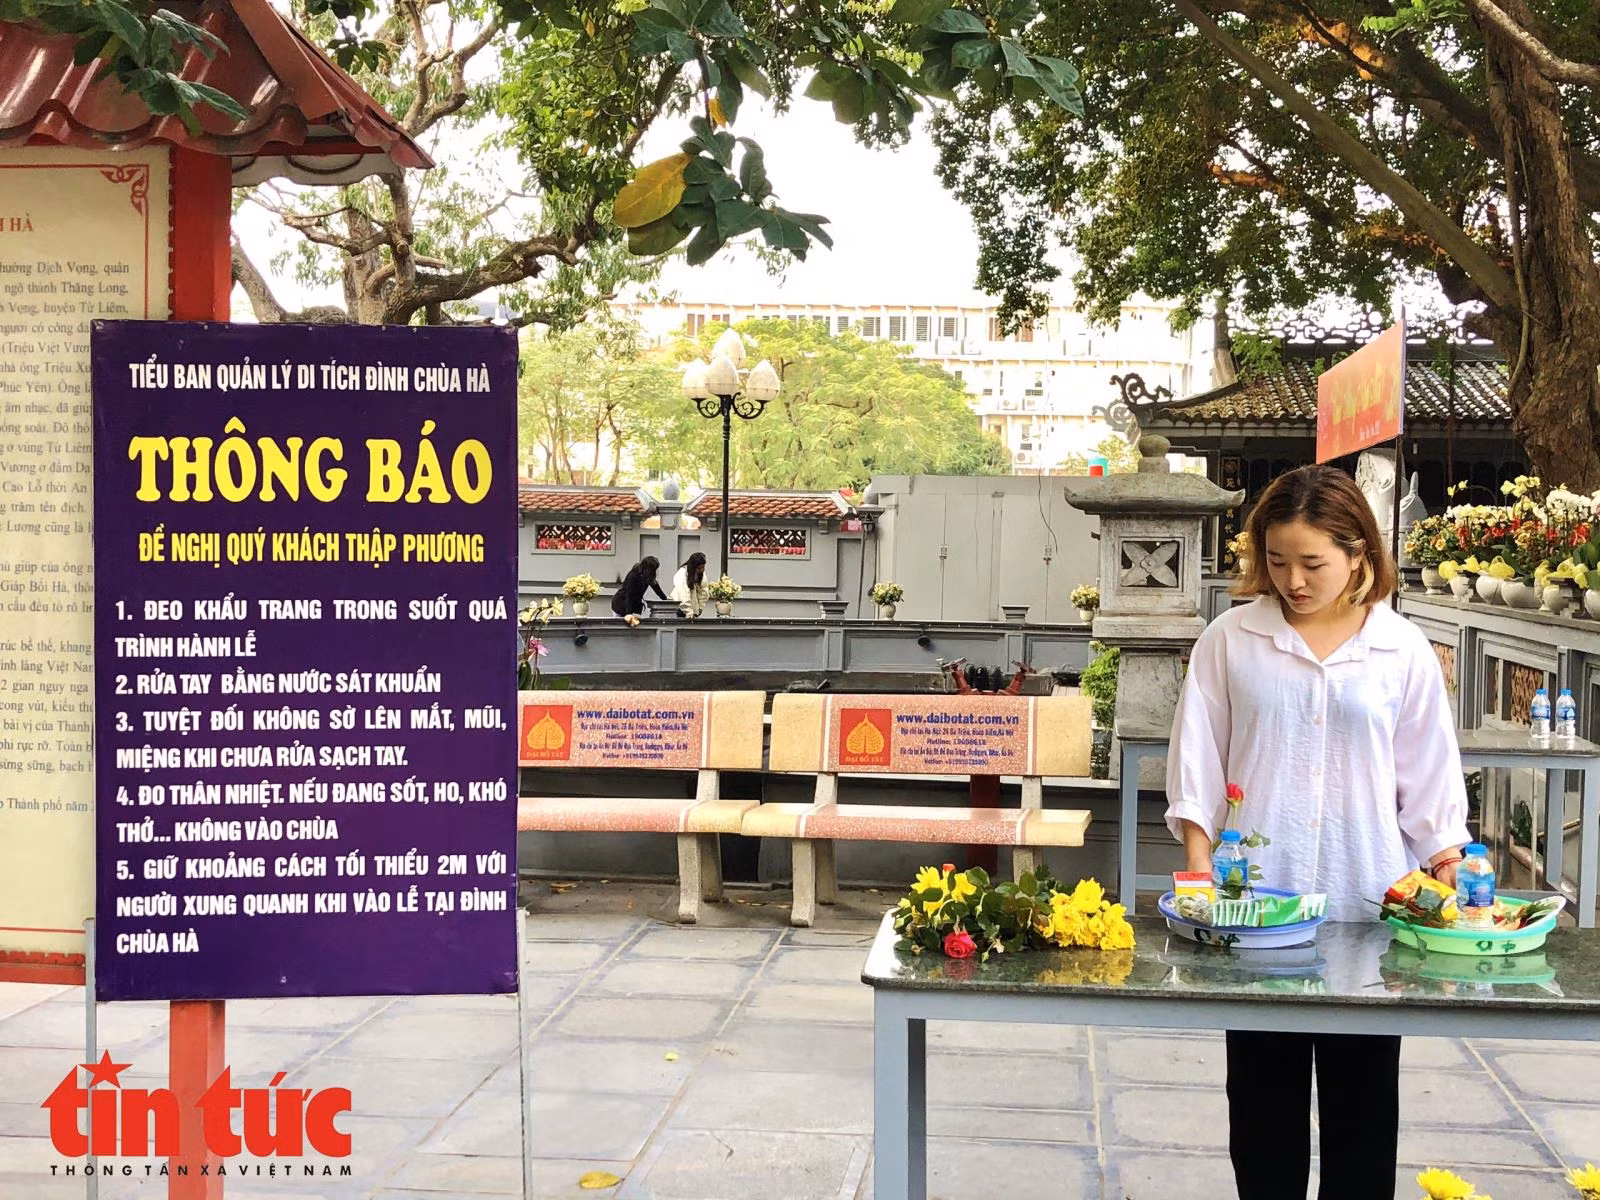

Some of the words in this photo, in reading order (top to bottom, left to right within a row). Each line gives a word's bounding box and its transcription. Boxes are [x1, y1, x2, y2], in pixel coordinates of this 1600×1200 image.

[9, 212, 33, 232] HÀ
[37, 262, 62, 275] Dịch
[103, 262, 129, 275] quận
[60, 282, 95, 296] Thăng
[43, 302, 76, 316] huyện
[32, 322, 44, 333] có
[48, 322, 73, 336] công
[2, 341, 34, 355] (Triệu
[38, 341, 60, 355] Việt
[20, 362, 39, 375] ông
[44, 361, 72, 375] Triệu
[129, 354, 168, 388] TIỂU
[174, 364, 211, 389] BAN
[217, 357, 266, 392] QUẢN
[272, 360, 292, 389] LÝ
[298, 365, 315, 389] DI
[321, 360, 360, 390] TÍCH
[365, 362, 408, 391] ĐÌNH
[414, 363, 461, 392] CHÙA
[467, 363, 490, 392] HÀ
[58, 378, 81, 396] Ông
[56, 402, 69, 413] đã
[18, 443, 43, 455] vùng
[129, 417, 347, 502] THÔNG
[366, 420, 492, 504] BÁO
[1, 461, 36, 476] Vương
[2, 481, 23, 492] Cao
[28, 479, 42, 492] Lỗ
[46, 481, 67, 493] thời
[72, 482, 87, 493] An
[11, 502, 35, 512] trăm
[40, 501, 56, 512] tên
[7, 520, 41, 535] Lương
[44, 521, 70, 535] cũng
[74, 521, 84, 533] là
[139, 523, 164, 561] ĐỀ
[172, 533, 220, 568] NGHỊ
[227, 527, 265, 565] QUÝ
[273, 527, 339, 561] KHÁCH
[345, 528, 396, 568] THẬP
[404, 532, 483, 562] PHƯƠNG
[14, 562, 37, 575] giúp
[41, 562, 59, 572] của
[63, 562, 83, 576] ông
[0, 580, 26, 595] Giáp
[116, 601, 132, 620] 1.
[144, 600, 182, 620] ĐEO
[195, 592, 247, 620] KHẨU
[259, 600, 321, 619] TRANG
[333, 600, 397, 619] TRONG
[409, 594, 457, 620] SUỐT
[469, 596, 507, 621] QUÁ
[21, 636, 33, 651] bề
[60, 640, 92, 656] khang
[115, 633, 173, 657] TRÌNH
[177, 633, 230, 657] HÀNH
[235, 630, 256, 656] LỄ
[21, 660, 43, 674] làng
[47, 660, 69, 675] Việt
[116, 675, 133, 694] 2.
[137, 668, 177, 694] RỬA
[180, 674, 212, 694] TAY
[222, 666, 274, 693] BẰNG
[279, 669, 331, 693] NƯỚC
[336, 669, 372, 692] SÁT
[376, 665, 440, 692] KHUẨN
[12, 681, 35, 693] gian
[39, 682, 65, 695] nguy
[70, 683, 89, 696] nga
[28, 700, 48, 713] vút,
[577, 708, 695, 720] www.daibotat.com.vn
[3, 719, 19, 730] bài
[23, 720, 32, 733] vị
[35, 720, 54, 731] của
[116, 712, 133, 731] 3.
[143, 707, 201, 735] TUYỆT
[210, 704, 243, 730] ĐỐI
[254, 706, 319, 730] KHÔNG
[330, 705, 356, 729] SỜ
[365, 706, 401, 729] LÊN
[411, 702, 454, 731] MẮT,
[465, 705, 506, 730] MŨI,
[896, 712, 1019, 725] www.daibotat.com.vn
[17, 742, 34, 752] rực
[117, 745, 180, 772] MIỆNG
[184, 748, 217, 767] KHI
[221, 745, 273, 767] CHƯA
[277, 740, 316, 766] RỬA
[319, 746, 370, 770] SẠCH
[374, 746, 408, 765] TAY.
[59, 760, 84, 773] bạch
[116, 786, 134, 805] 4.
[138, 785, 165, 805] ĐO
[169, 781, 220, 805] THÂN
[225, 780, 284, 808] NHIỆT.
[290, 777, 328, 803] NẾU
[332, 783, 385, 802] ĐANG
[390, 776, 429, 804] SỐT,
[434, 782, 464, 804] HO,
[469, 778, 506, 801] KHÓ
[7, 798, 40, 810] Thành
[43, 796, 62, 813] phố
[65, 801, 88, 812] năm
[116, 816, 171, 842] THỞ...
[175, 817, 241, 841] KHÔNG
[245, 817, 282, 840] VÀO
[287, 816, 338, 840] CHÙA
[117, 860, 134, 880] 5.
[144, 855, 179, 879] GIỮ
[186, 852, 265, 878] KHOẢNG
[275, 853, 326, 877] CÁCH
[335, 849, 365, 876] TỐI
[374, 848, 428, 875] THIỂU
[438, 855, 466, 874] 2M
[476, 850, 506, 874] VỚI
[117, 891, 176, 916] NGƯỜI
[183, 895, 236, 915] XUNG
[243, 894, 308, 916] QUANH
[315, 893, 346, 913] KHI
[353, 889, 390, 914] VÀO
[397, 885, 418, 912] LỄ
[425, 892, 454, 915] TẠI
[460, 887, 506, 911] ĐÌNH
[117, 929, 169, 953] CHÙA
[173, 928, 199, 952] HÀ
